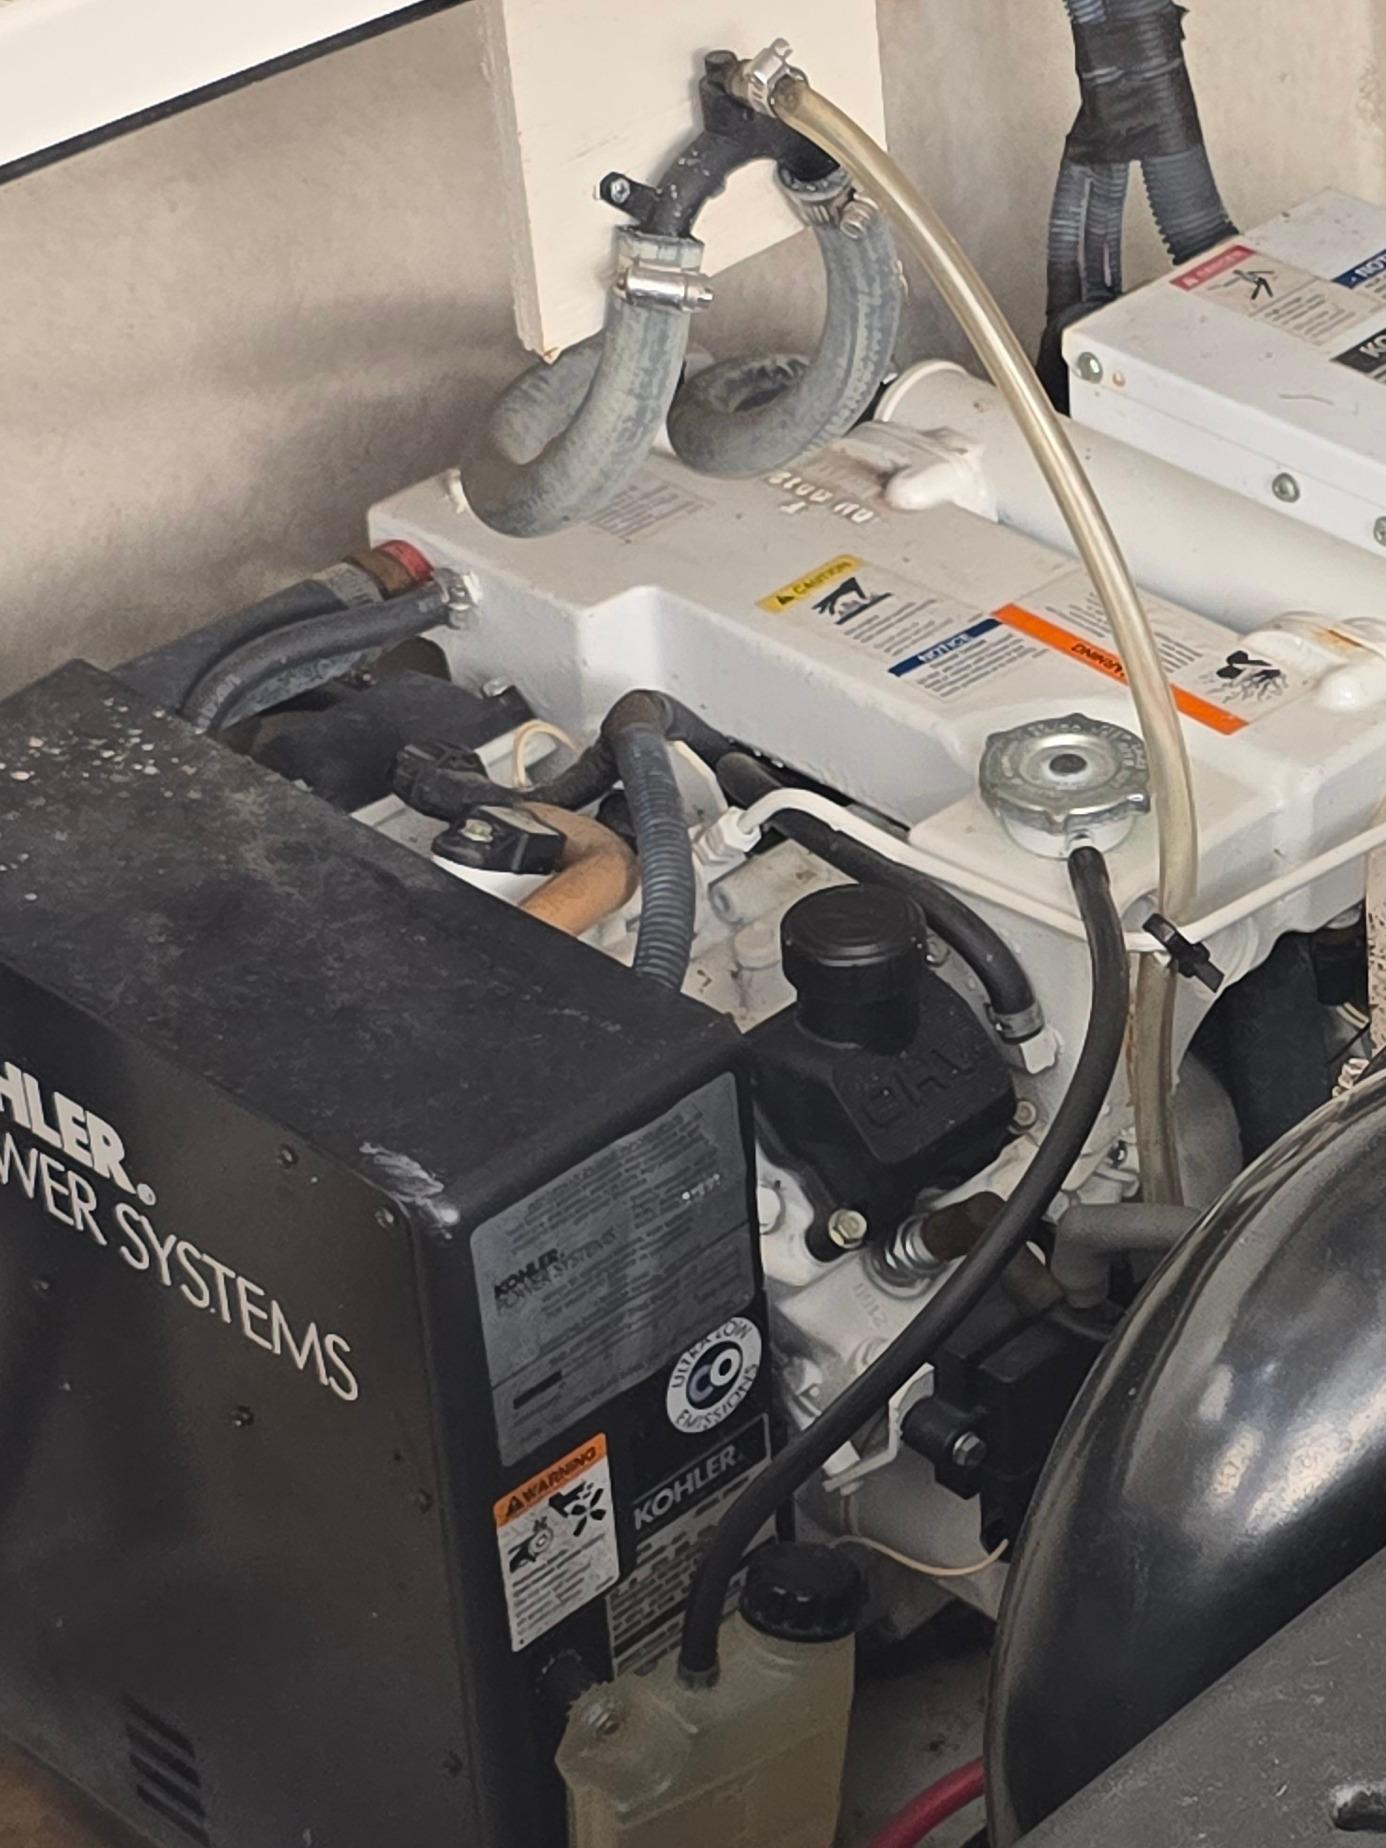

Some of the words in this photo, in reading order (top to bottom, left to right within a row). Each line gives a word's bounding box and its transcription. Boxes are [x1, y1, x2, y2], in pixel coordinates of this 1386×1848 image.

[791, 560, 853, 596] CAUTION
[917, 633, 973, 663] NOTICE
[1071, 642, 1124, 677] ARNING
[115, 1202, 358, 1401] SYSTEMS
[675, 1363, 759, 1429] EMISSIONS
[689, 1349, 740, 1402] CO
[520, 1445, 595, 1502] WARNING
[633, 1443, 738, 1531] KOHLER
